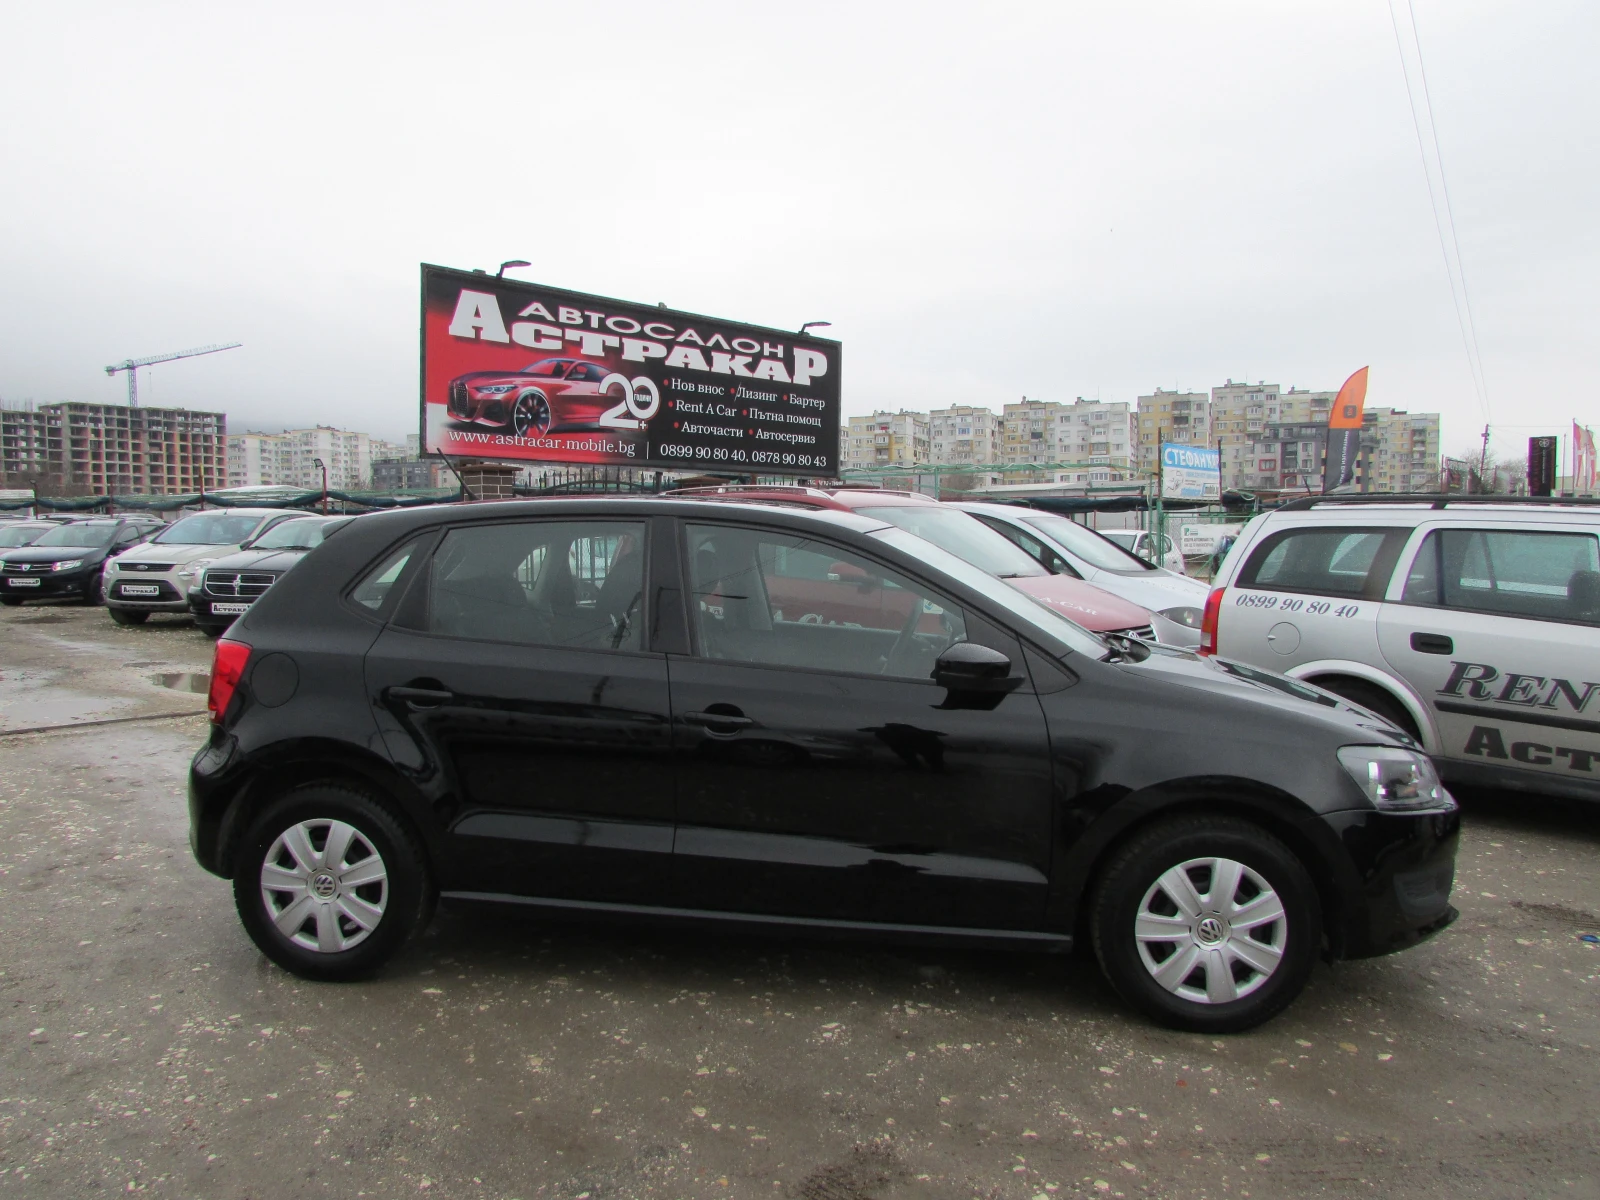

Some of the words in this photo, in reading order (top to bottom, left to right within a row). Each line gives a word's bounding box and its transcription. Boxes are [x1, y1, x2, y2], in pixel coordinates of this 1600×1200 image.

[518, 302, 784, 358] АВТОСАЛОН
[671, 378, 695, 392] Нов
[698, 384, 725, 396] внос
[736, 386, 778, 402] Лизинг
[789, 393, 825, 410] Бартер
[675, 399, 703, 414] Rent
[705, 403, 714, 415] A
[716, 404, 737, 417] Car
[749, 408, 784, 422] Пътна
[786, 414, 822, 427] помощ
[449, 430, 636, 457] www.astracar.mobile.bg
[681, 421, 744, 438] Авточасти
[755, 428, 816, 445] Автосервиз
[660, 443, 693, 458] 0899
[695, 446, 711, 459] 90
[713, 447, 728, 460] 80
[731, 449, 749, 463] 40,
[752, 450, 780, 464] 0878
[782, 452, 796, 465] 90
[798, 454, 812, 466] 80
[813, 455, 827, 467] 43
[1235, 593, 1278, 609] 0899
[1279, 598, 1304, 612] 90
[1305, 600, 1331, 615] 80
[1334, 604, 1359, 618] 40
[1435, 661, 1600, 713] REN
